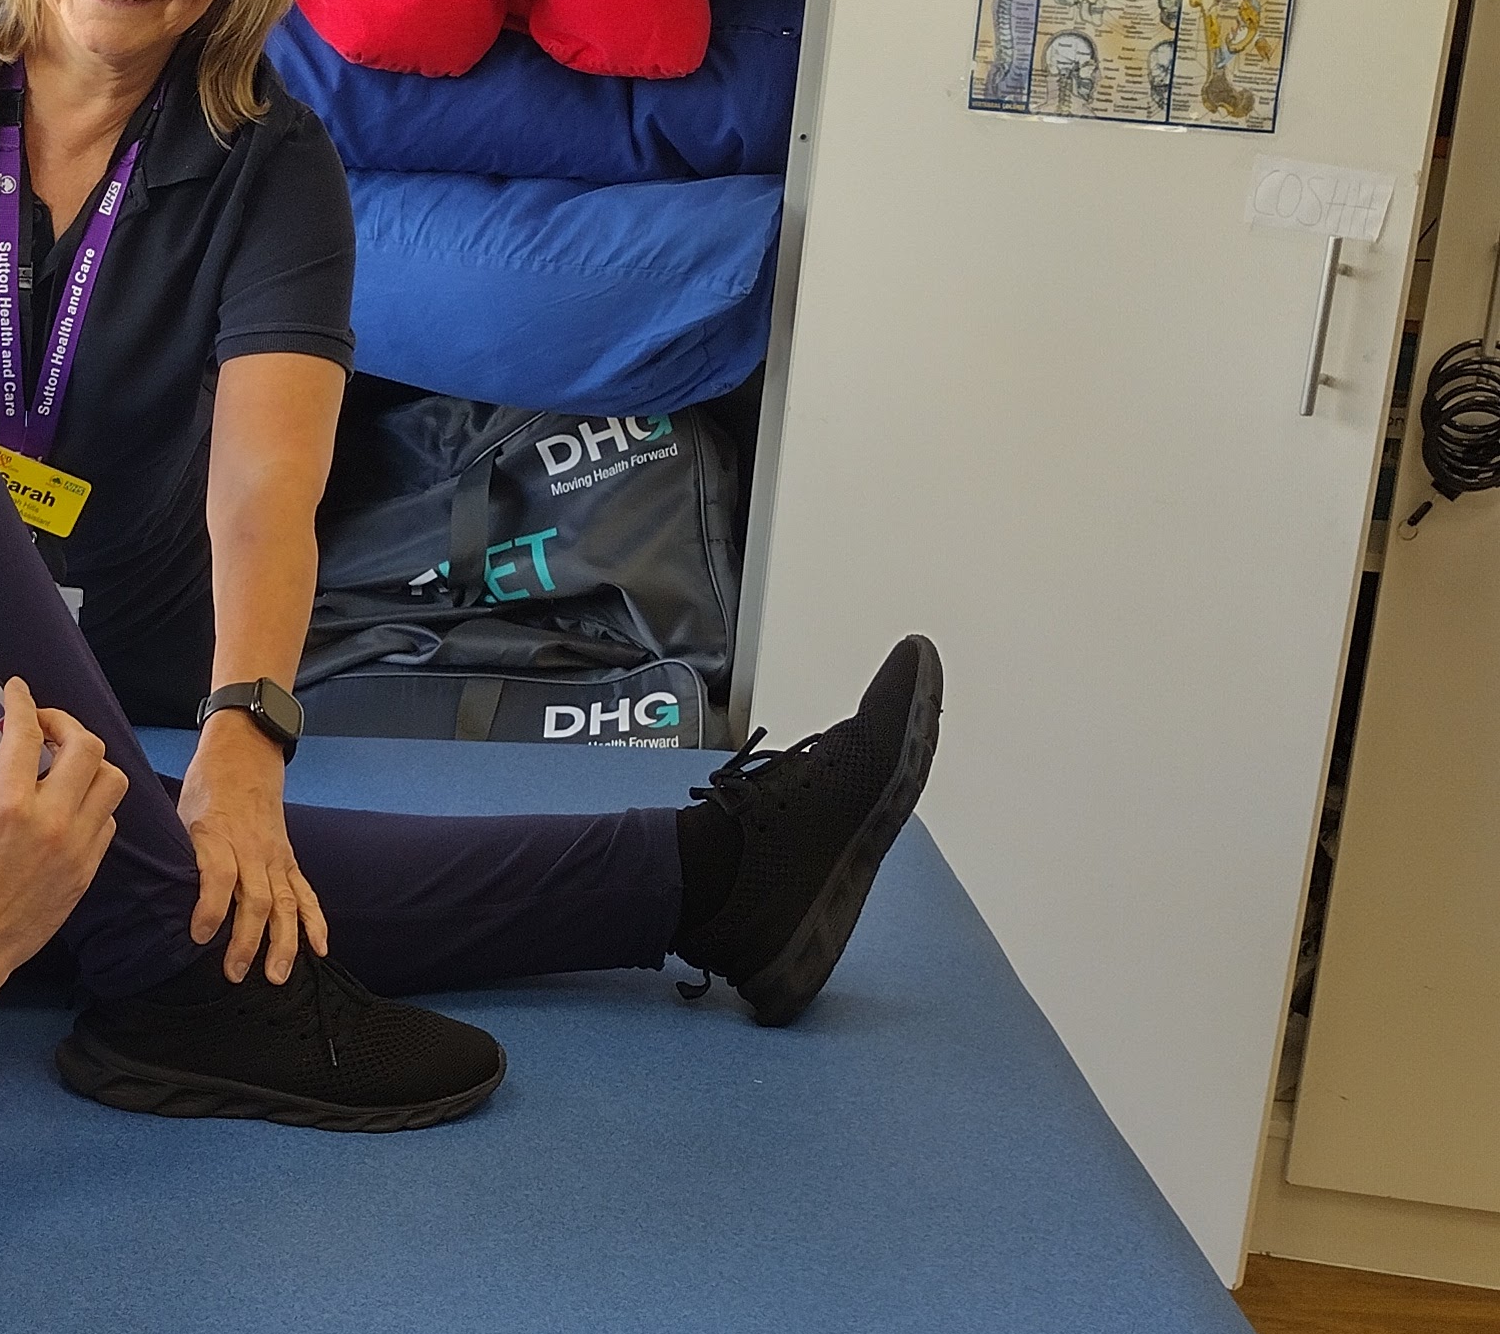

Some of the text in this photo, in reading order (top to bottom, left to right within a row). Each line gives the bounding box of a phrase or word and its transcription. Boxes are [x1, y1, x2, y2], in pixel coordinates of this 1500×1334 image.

[99, 181, 121, 215] NHS
[1254, 169, 1378, 235] COSHH
[0, 241, 16, 417] Sutton Health and Care
[38, 248, 96, 416] Sutton Health and Care
[536, 416, 673, 476] DHG
[1, 471, 56, 508] Sarah
[64, 481, 86, 496] NHS
[550, 443, 678, 496] Moving Health Forward
[19, 509, 51, 527] Assistant
[24, 499, 39, 513] Hills
[544, 691, 680, 739] DHG
[629, 735, 679, 748] Forward
